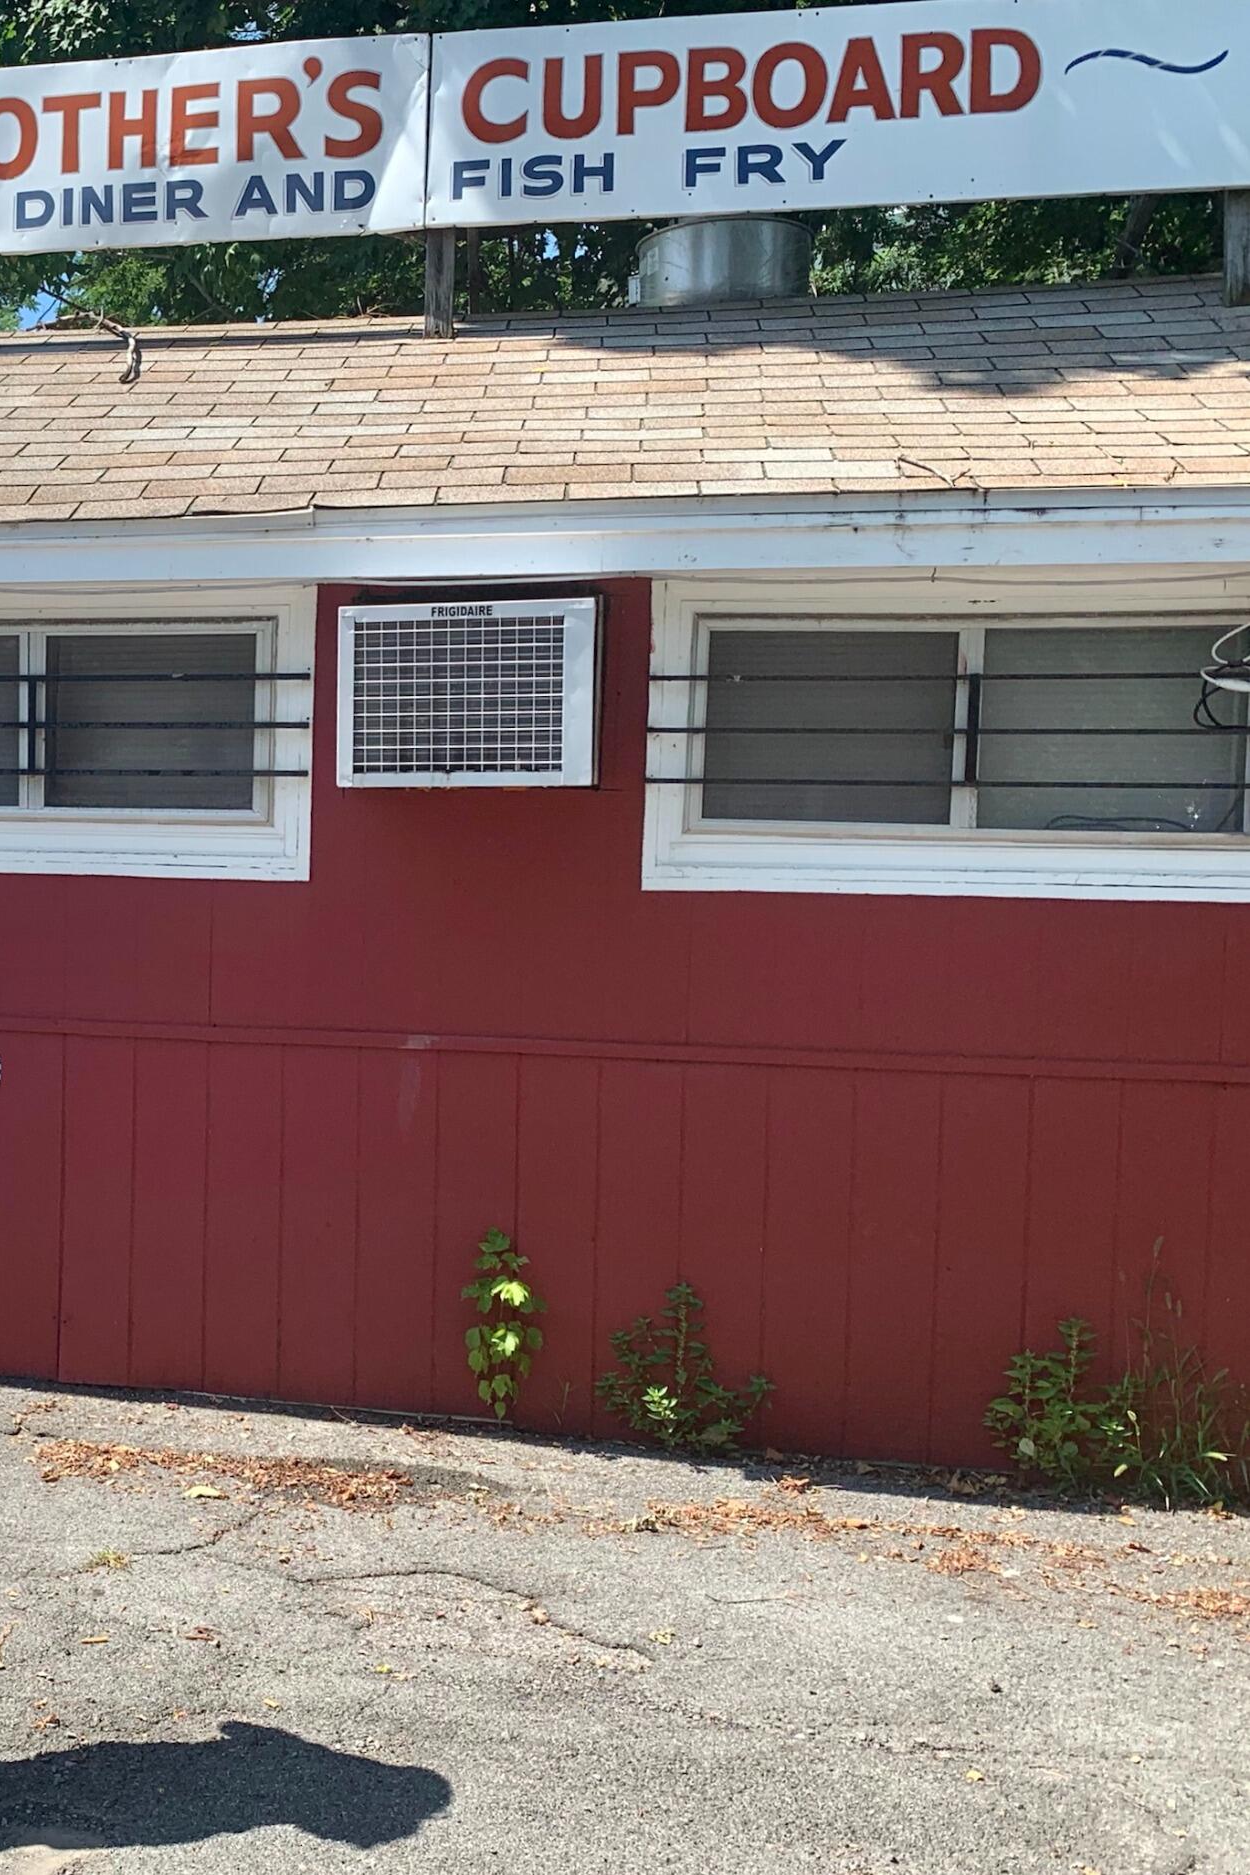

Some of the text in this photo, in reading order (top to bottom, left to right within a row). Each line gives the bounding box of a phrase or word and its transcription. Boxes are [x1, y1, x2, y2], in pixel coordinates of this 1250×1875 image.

[461, 28, 1043, 144] CUPBOARD
[13, 139, 847, 232] DINER AND FISH FRY
[430, 604, 494, 618] FRIGIDAIRE
